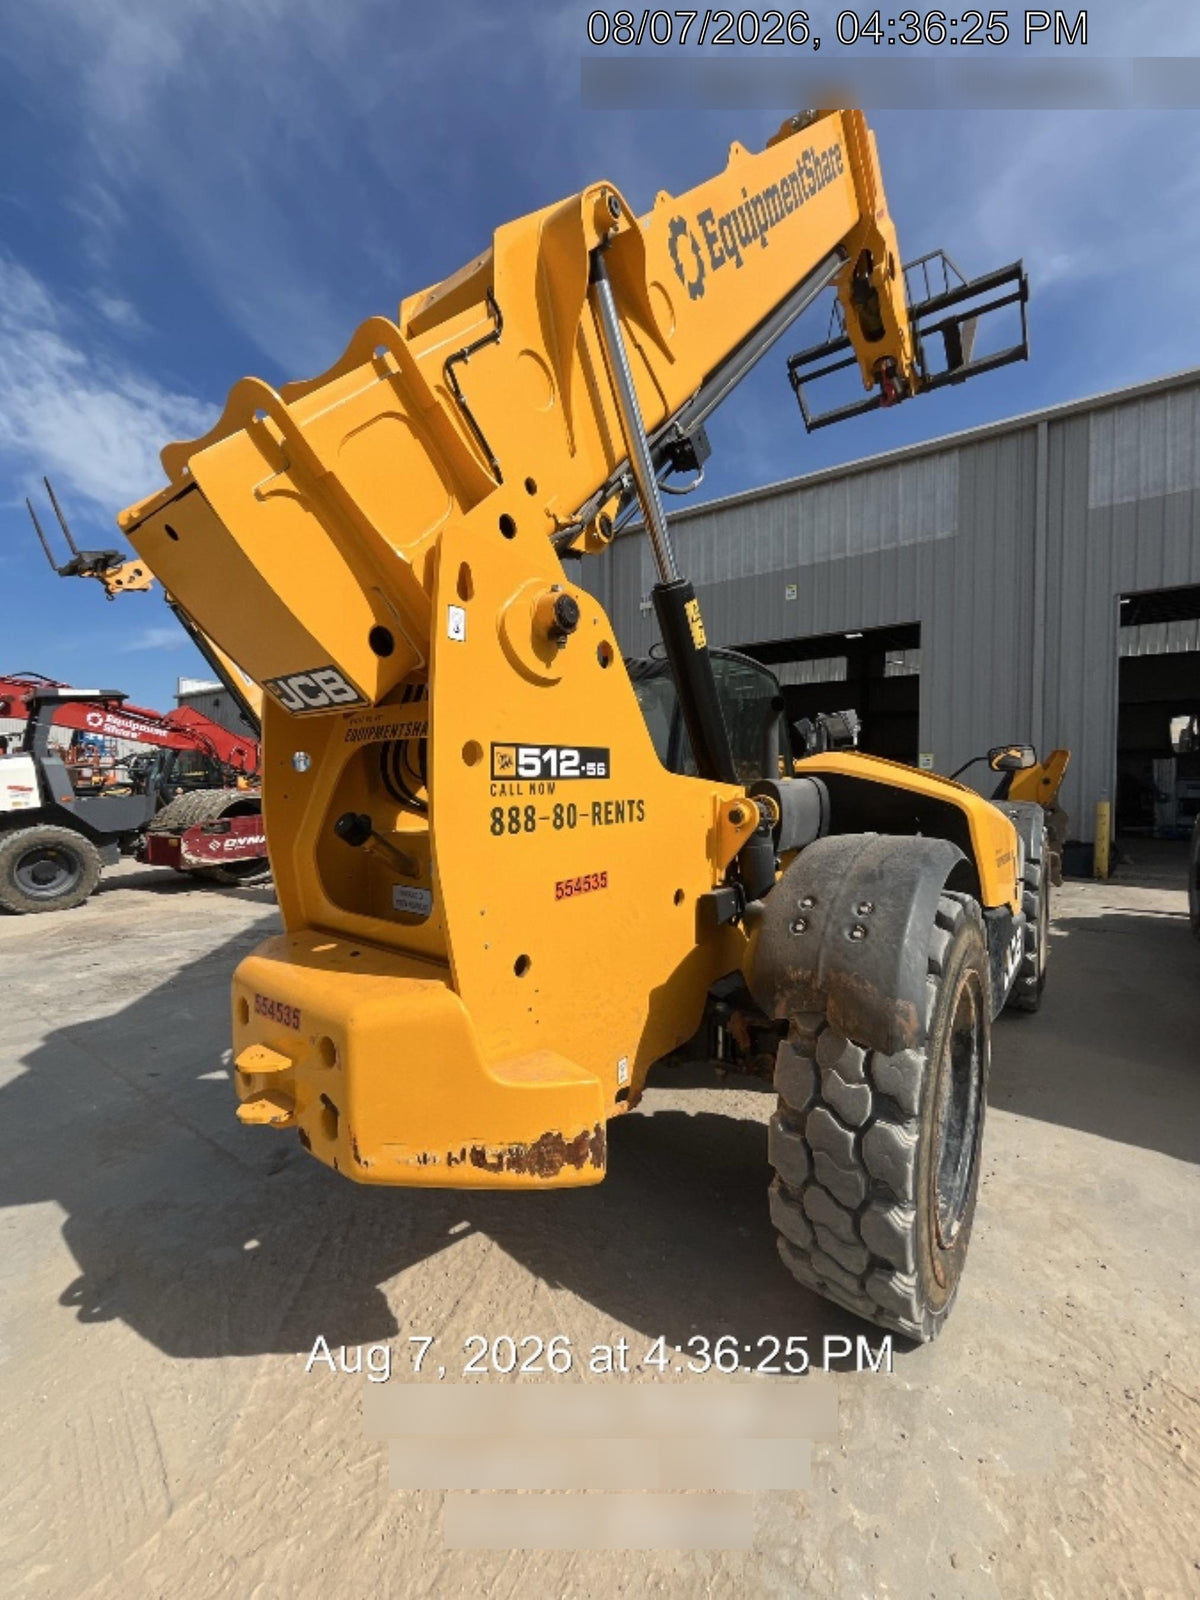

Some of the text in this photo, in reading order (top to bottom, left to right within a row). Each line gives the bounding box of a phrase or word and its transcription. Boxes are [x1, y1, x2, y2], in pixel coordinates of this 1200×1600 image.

[697, 143, 844, 272] EquipmentShare
[277, 670, 359, 711] JCB
[490, 782, 556, 797] CALL NOW
[490, 799, 645, 836] 888-80-RENTS
[554, 870, 609, 901] 554535
[254, 992, 301, 1031] 554535
